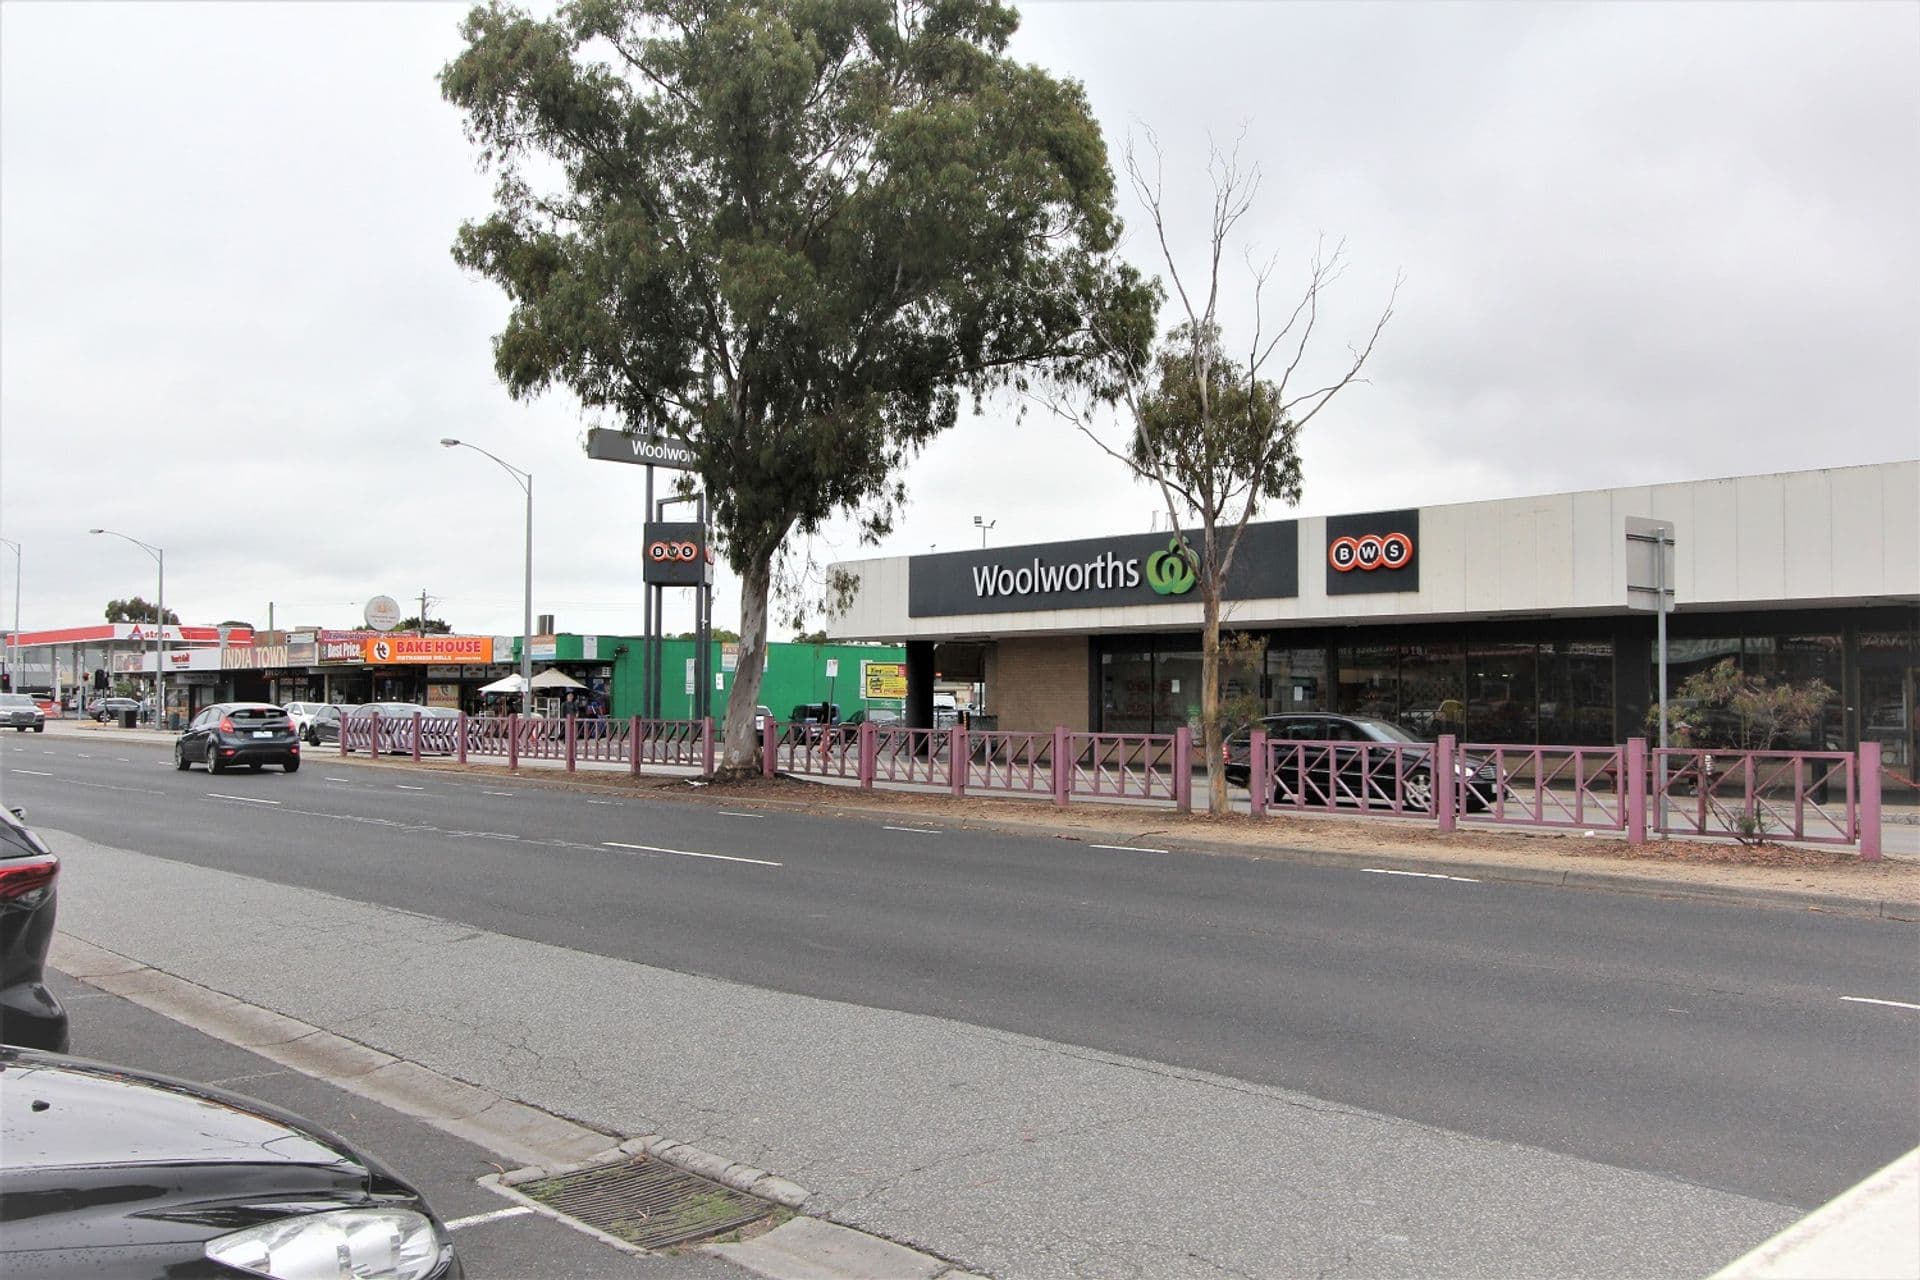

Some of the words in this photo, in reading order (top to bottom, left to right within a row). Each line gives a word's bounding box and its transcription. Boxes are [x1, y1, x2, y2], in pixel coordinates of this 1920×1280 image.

[632, 440, 700, 462] Woolwor
[1338, 544, 1400, 561] BWS
[972, 551, 1140, 597] Woolworths
[128, 624, 171, 640] Astrn
[397, 641, 431, 653] BAKE
[435, 641, 481, 653] HOUSE
[222, 647, 252, 669] INDIA
[256, 645, 288, 668] TOWN
